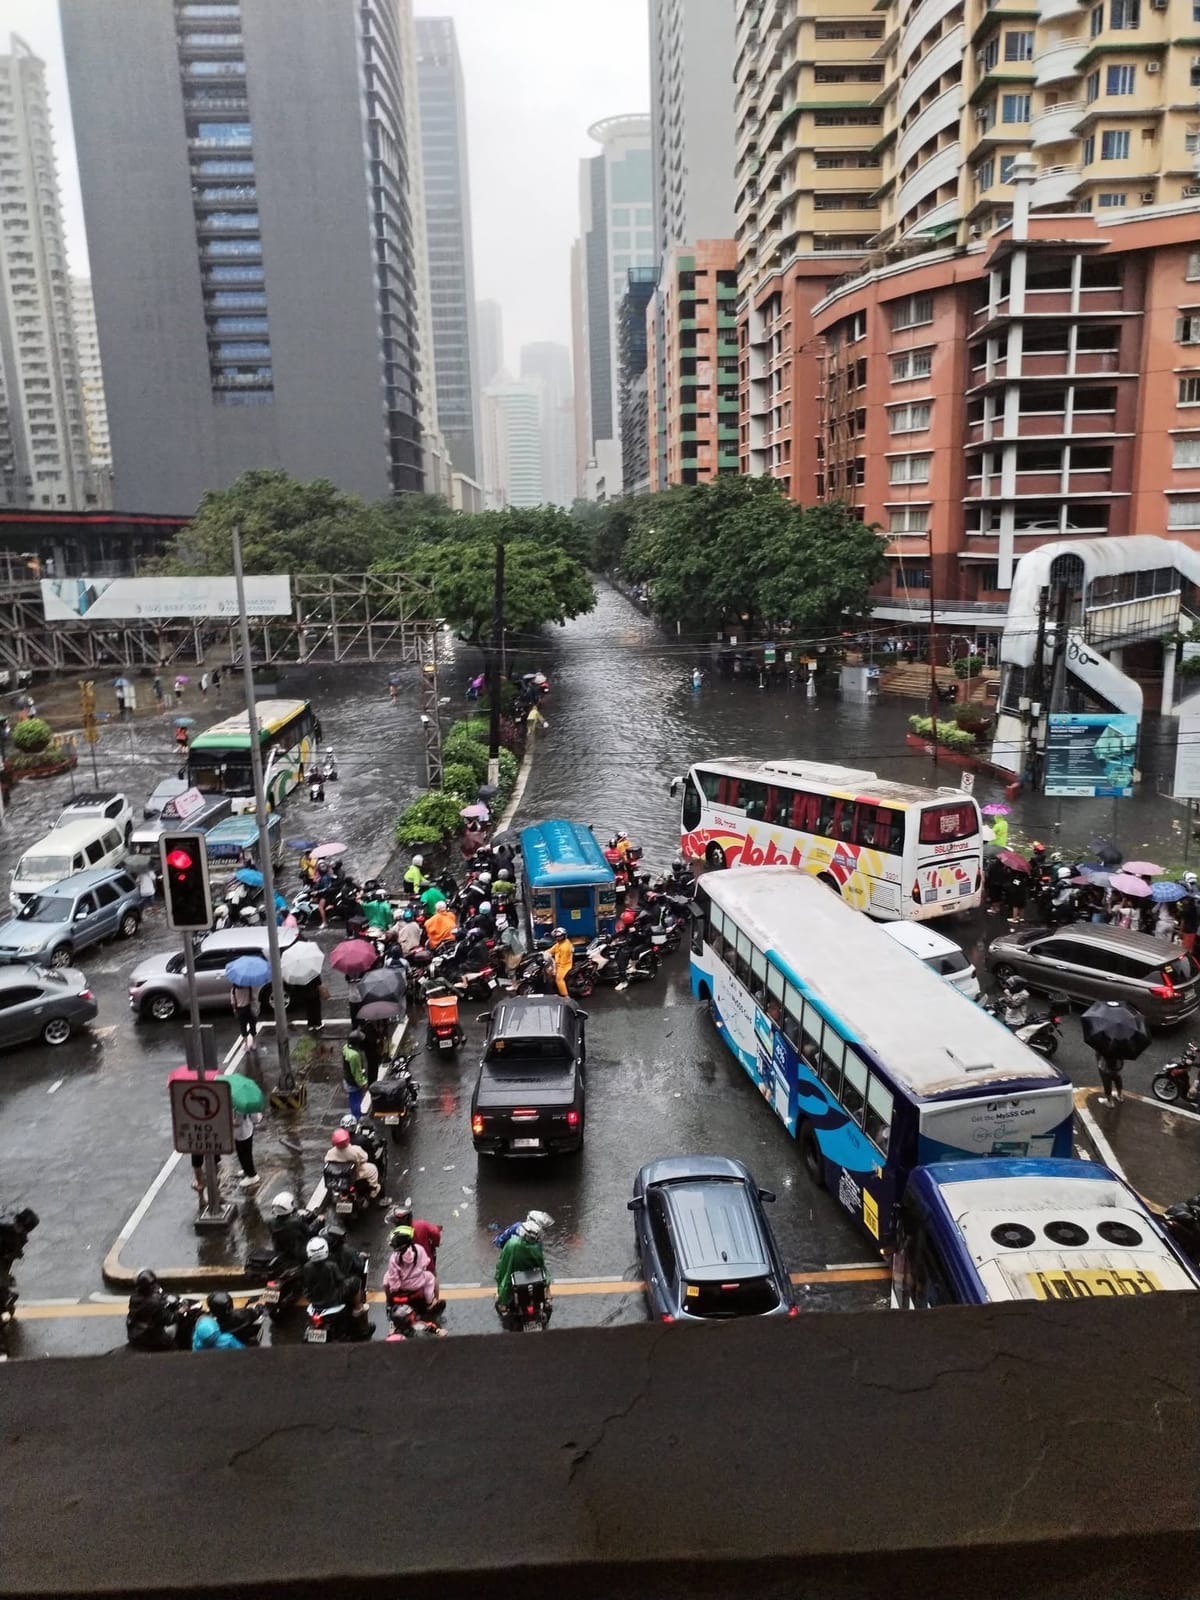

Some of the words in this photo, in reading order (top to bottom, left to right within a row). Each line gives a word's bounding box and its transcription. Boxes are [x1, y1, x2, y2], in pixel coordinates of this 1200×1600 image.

[194, 1123, 213, 1132] NO
[187, 1132, 219, 1141] LEFT
[188, 1141, 223, 1150] TURN
